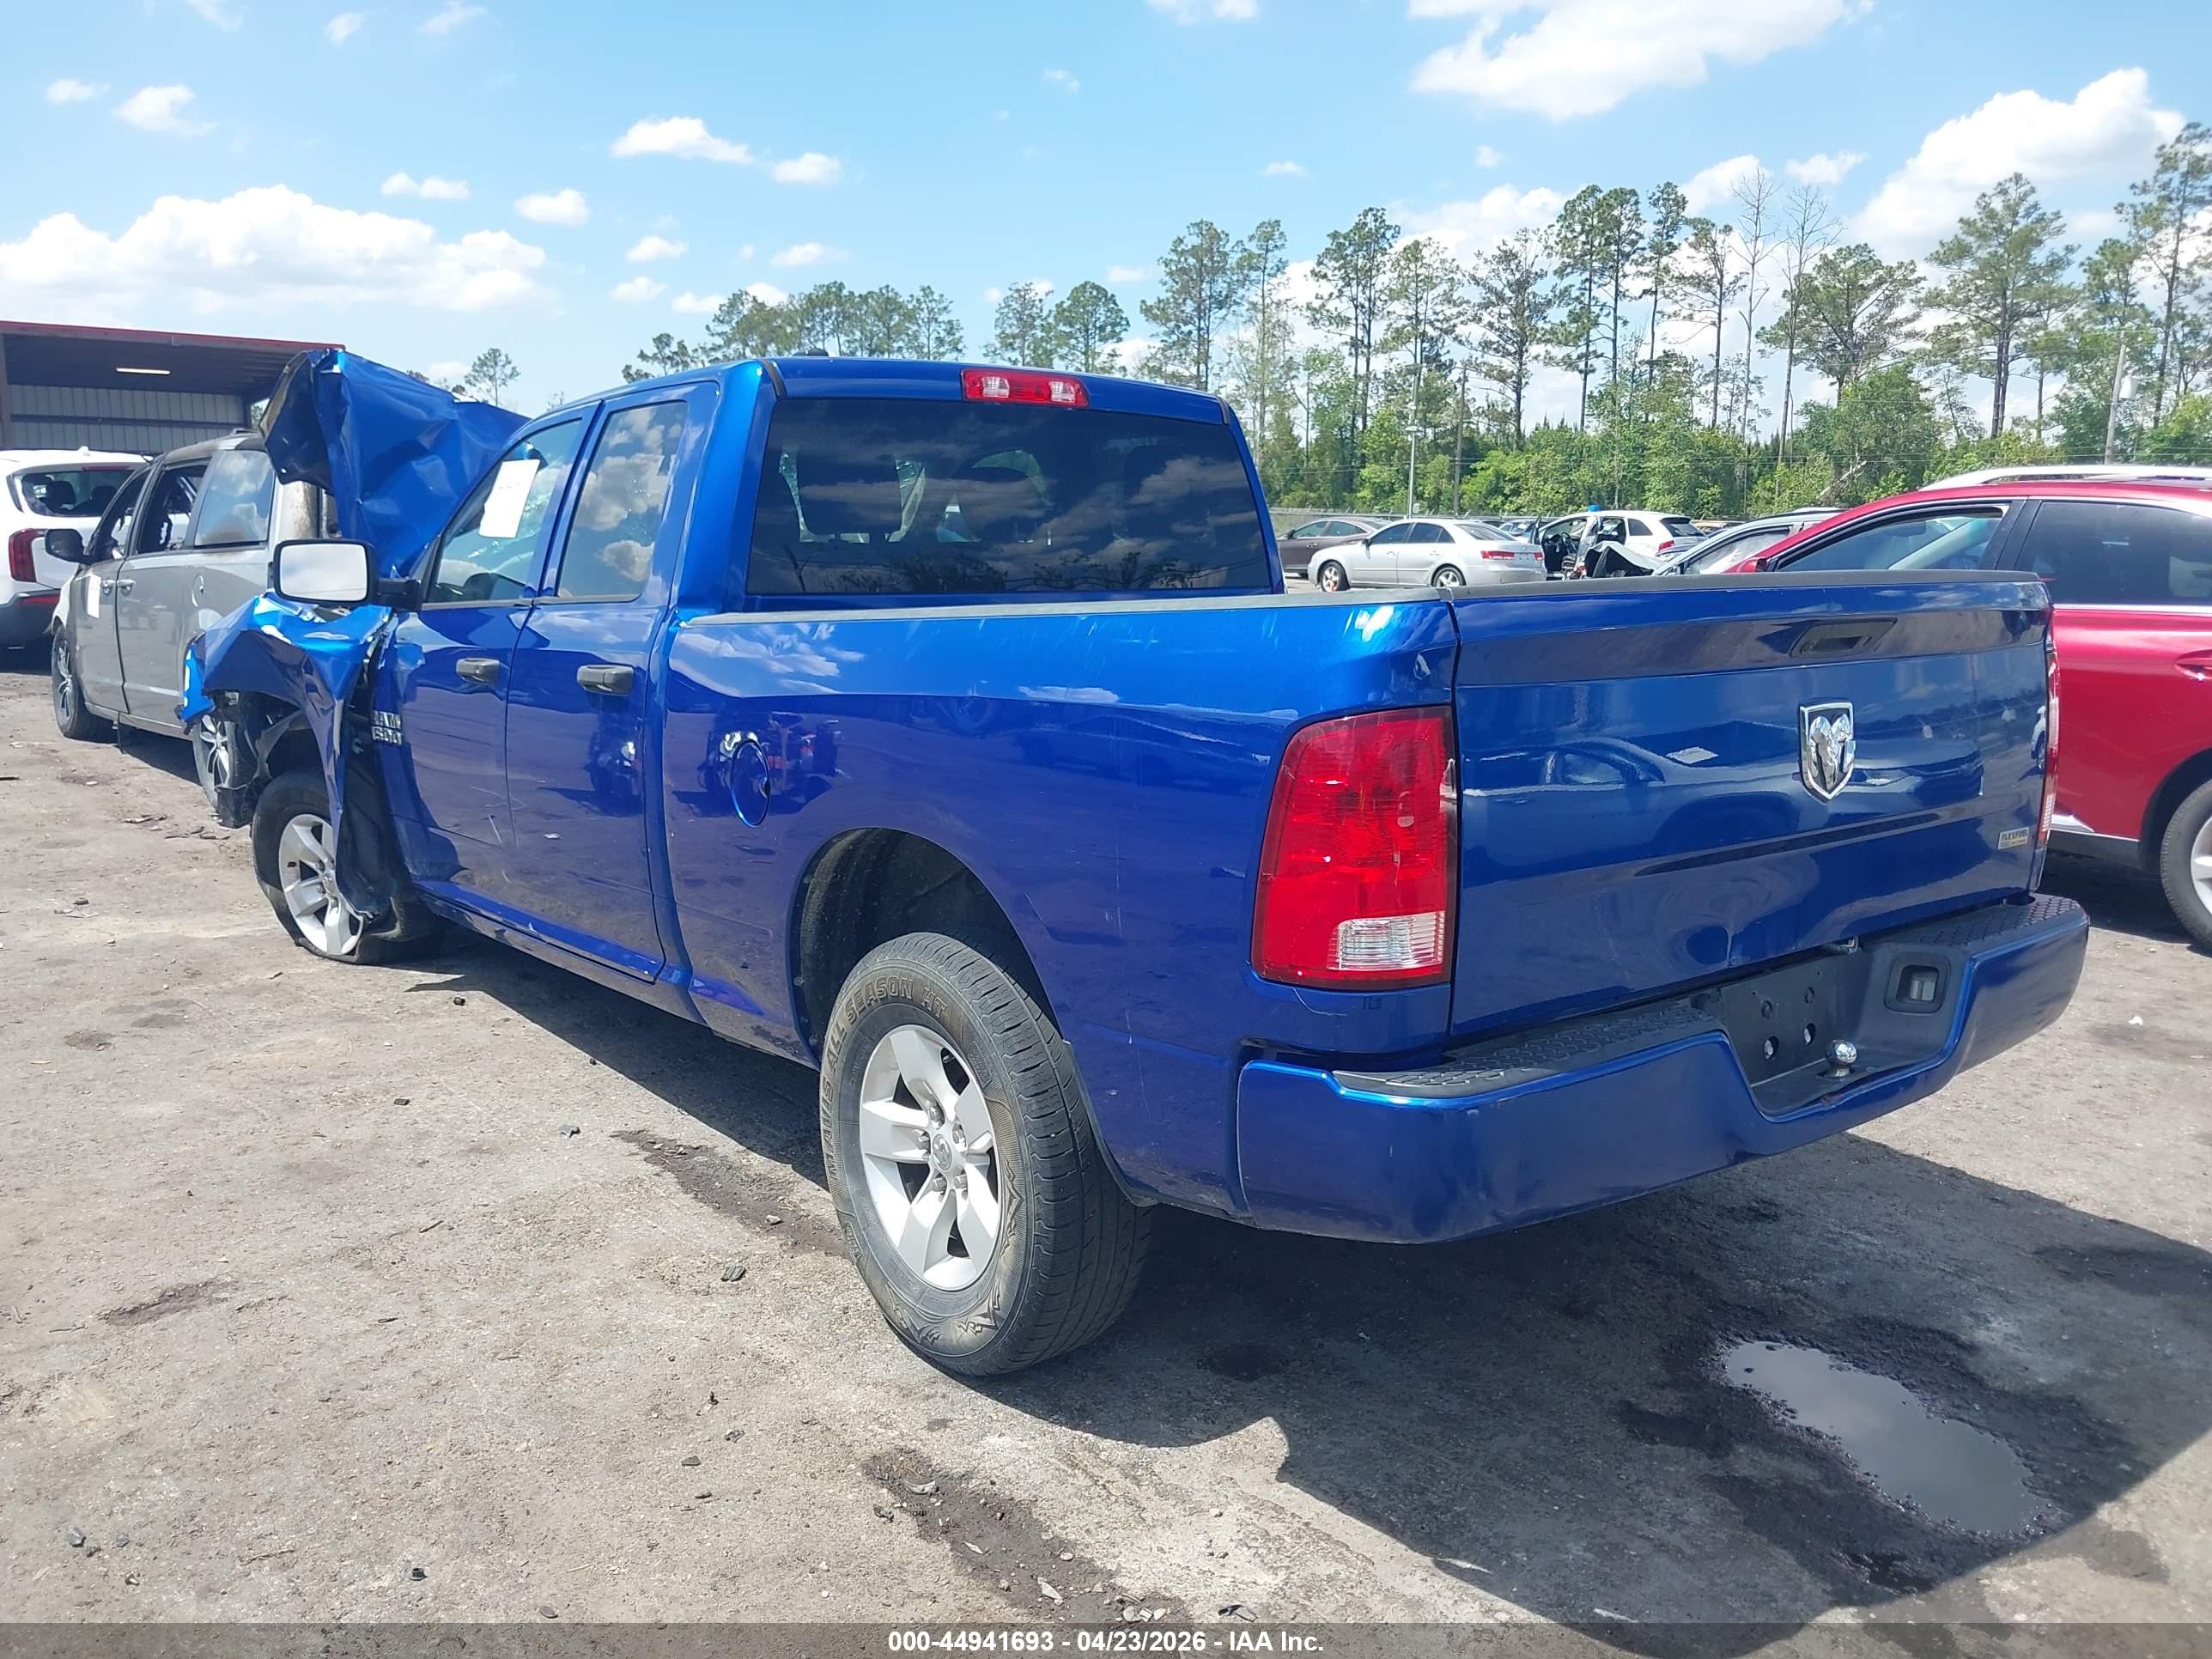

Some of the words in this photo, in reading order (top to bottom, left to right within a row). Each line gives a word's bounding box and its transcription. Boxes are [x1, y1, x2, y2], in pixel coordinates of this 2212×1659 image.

[827, 1021, 847, 1074] ALL
[845, 975, 915, 1024] SEASON
[921, 987, 948, 1018] HT
